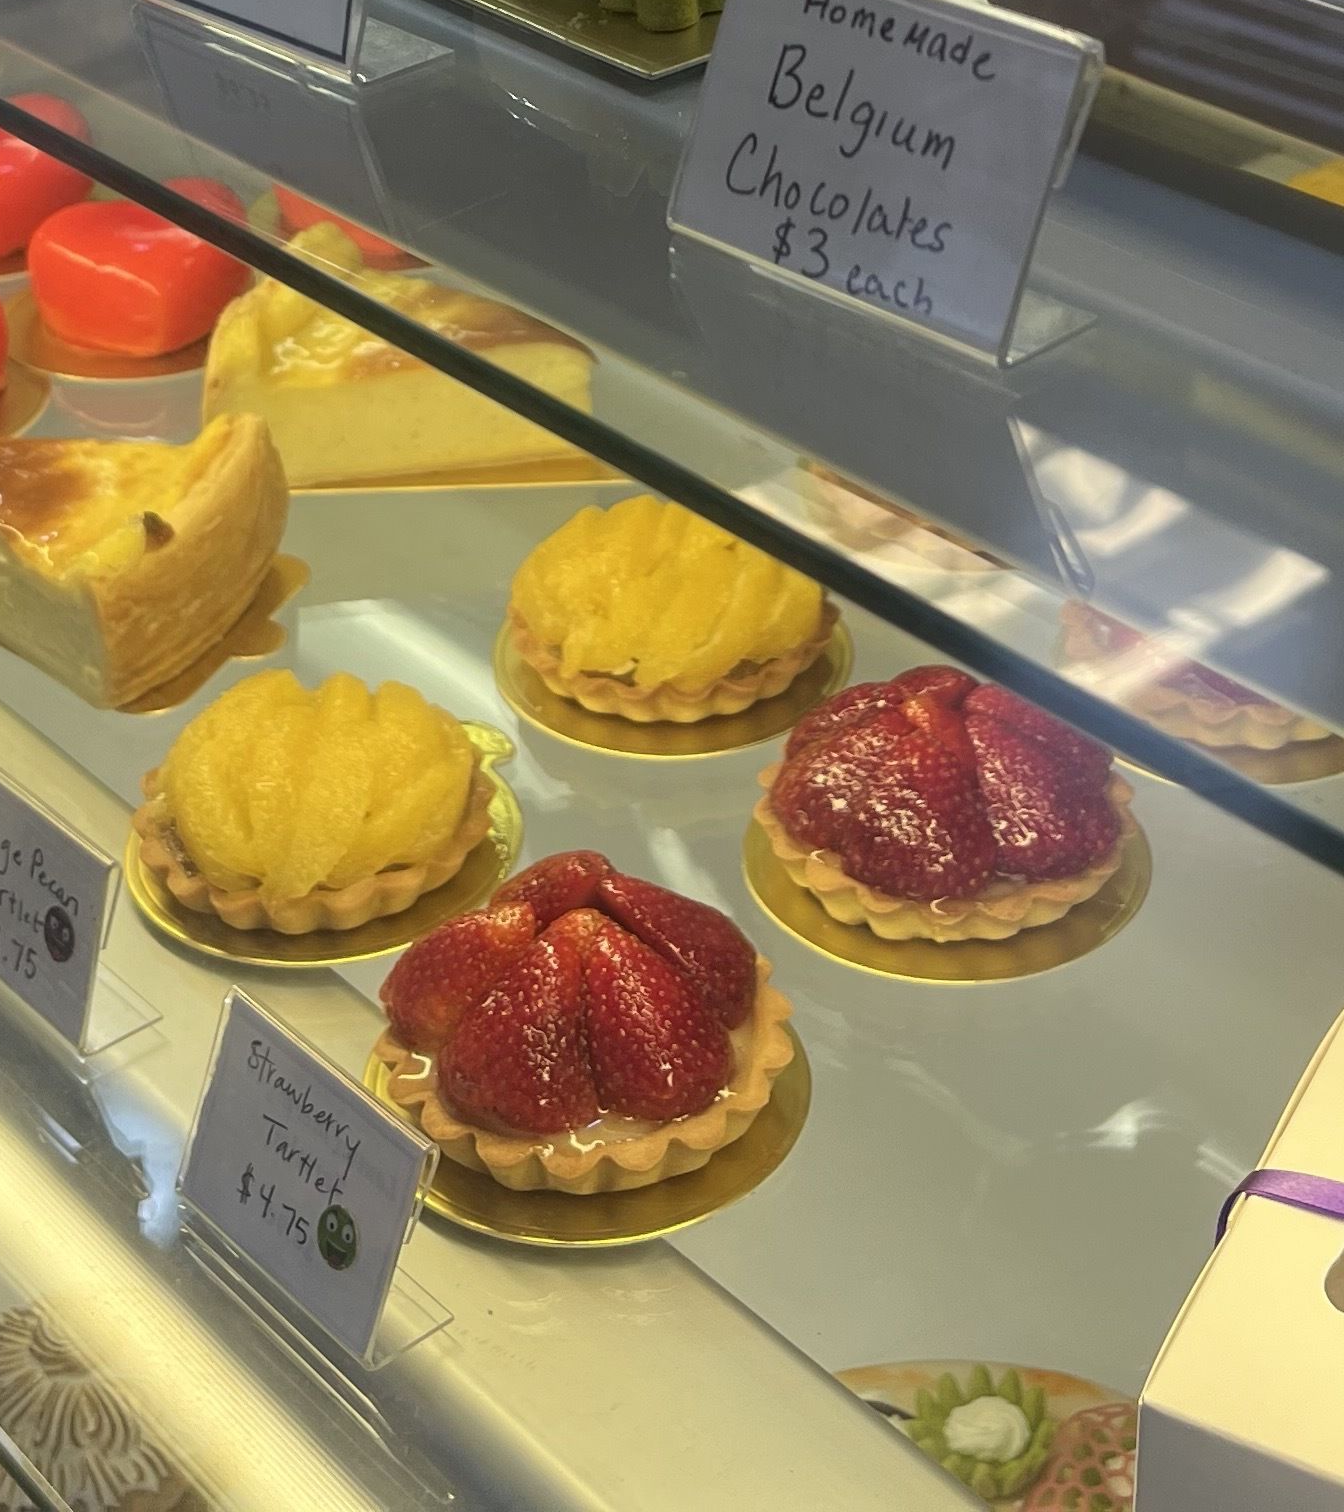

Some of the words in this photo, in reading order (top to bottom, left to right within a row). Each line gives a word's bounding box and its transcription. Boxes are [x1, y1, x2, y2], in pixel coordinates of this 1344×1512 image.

[767, 43, 956, 170] Belgium
[725, 132, 953, 254] Chocolates
[846, 264, 934, 315] each
[29, 847, 80, 917] Pecan
[246, 1039, 362, 1181] Strawberry
[236, 1161, 311, 1247] $4.75
[262, 1113, 345, 1206] Tartlet
